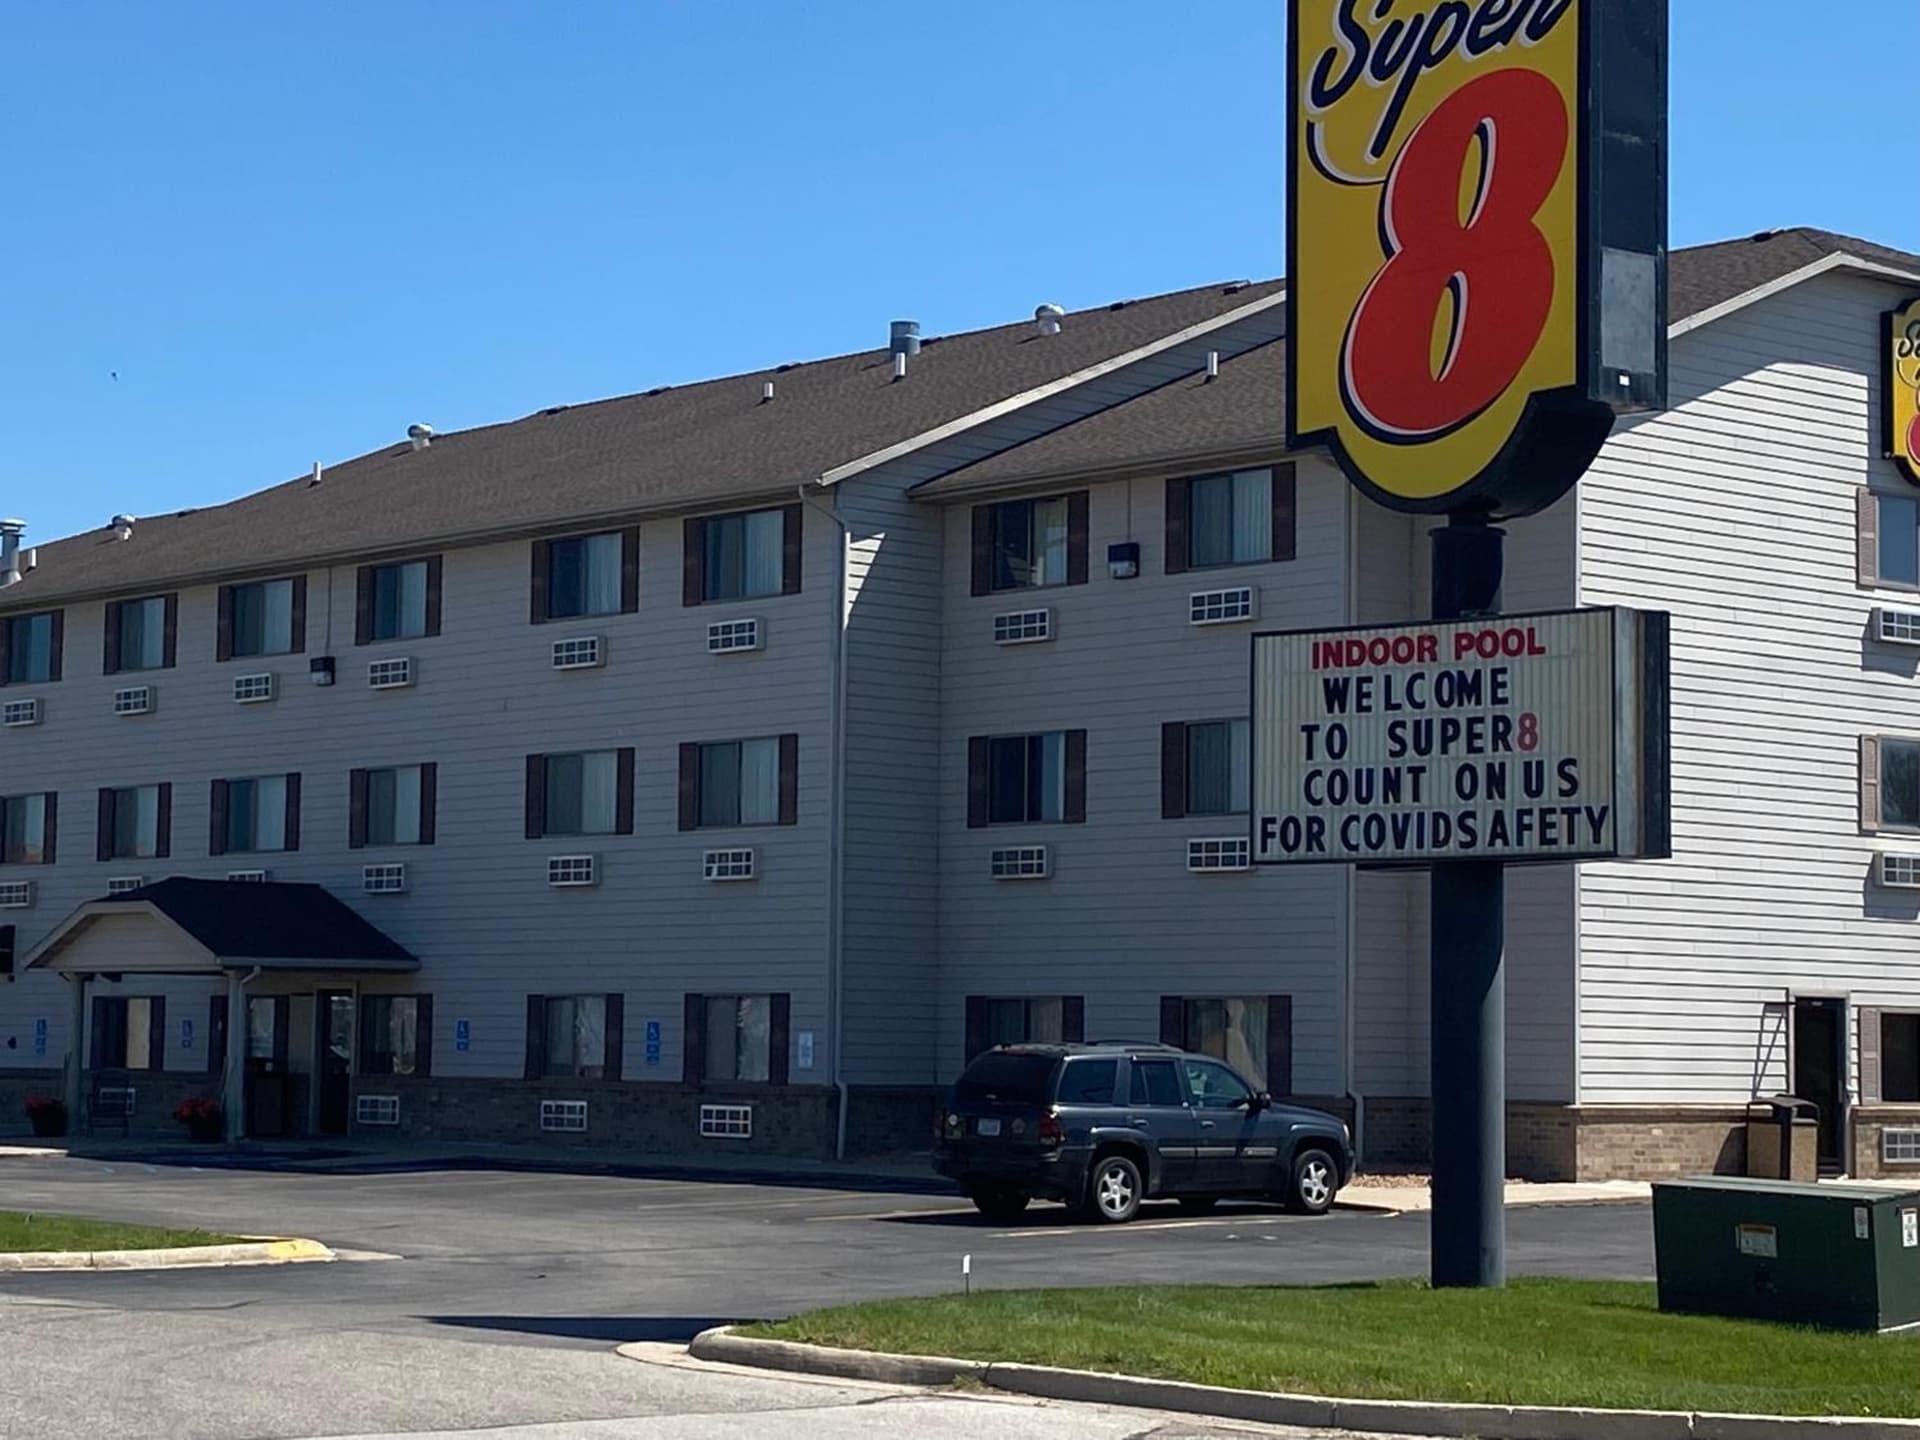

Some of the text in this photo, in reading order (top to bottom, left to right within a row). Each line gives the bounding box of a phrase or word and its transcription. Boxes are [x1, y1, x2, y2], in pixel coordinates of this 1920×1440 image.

[1338, 67, 1569, 446] 8
[1312, 628, 1546, 669] INDOOR POOL
[1323, 667, 1509, 714] WELCOME
[1301, 723, 1348, 761] TO
[1304, 767, 1427, 806] COUNT
[1260, 816, 1326, 853] FOR
